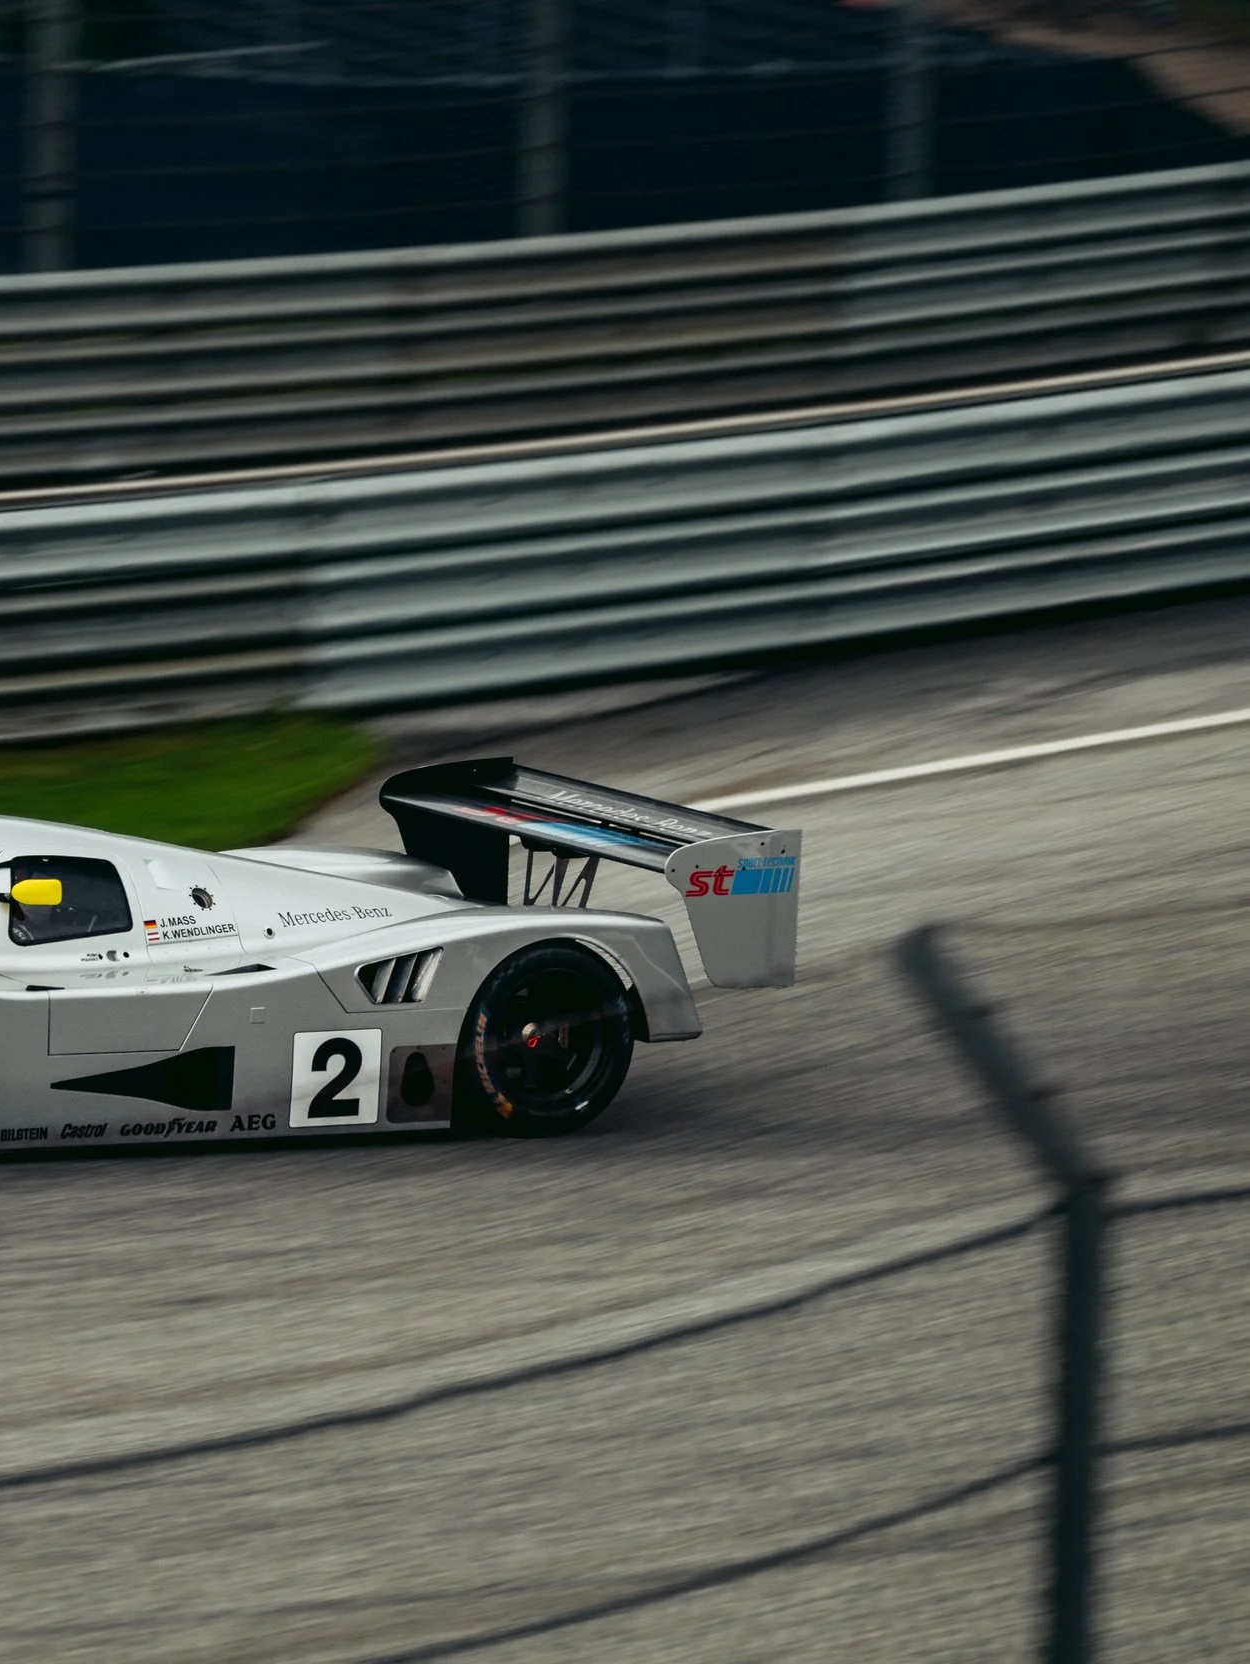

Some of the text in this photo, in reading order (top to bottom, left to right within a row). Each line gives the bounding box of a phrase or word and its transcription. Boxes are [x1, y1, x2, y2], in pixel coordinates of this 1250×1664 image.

[277, 906, 393, 928] Mercedes-Benz
[162, 923, 236, 940] K.WENDLINGER
[307, 1037, 363, 1119] 2
[0, 1114, 276, 1142] BILSTEIN Castrol GOODYEAR AEG
